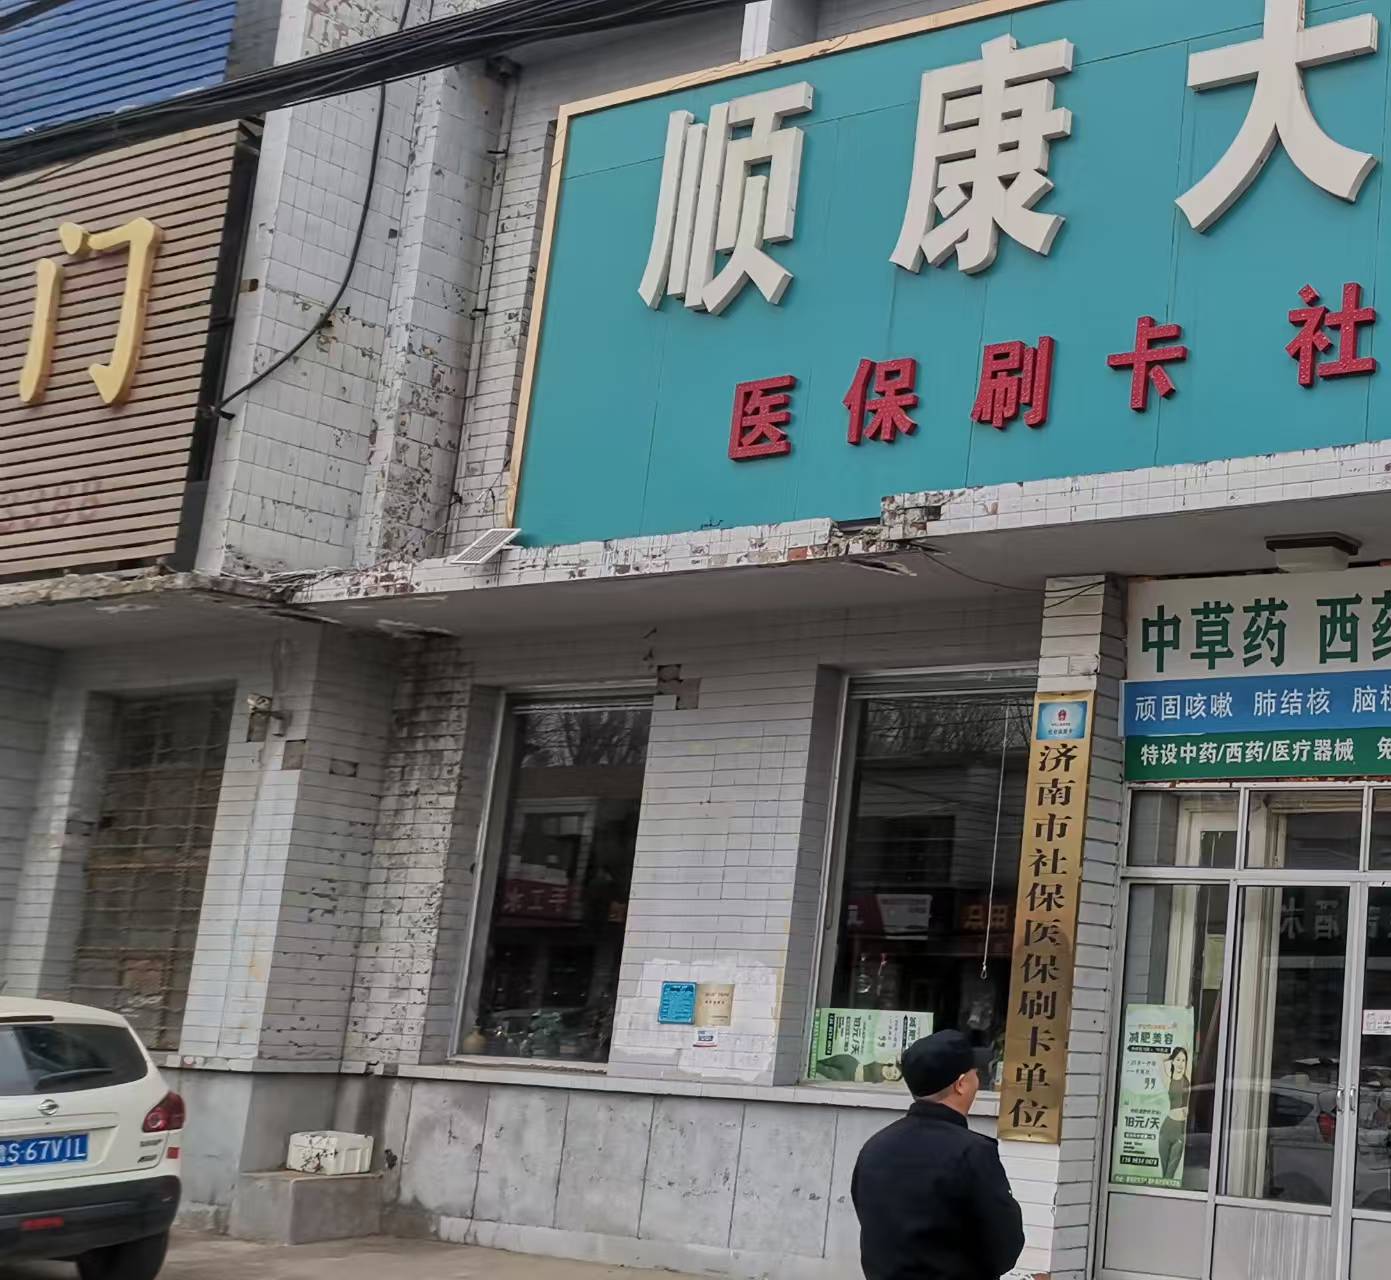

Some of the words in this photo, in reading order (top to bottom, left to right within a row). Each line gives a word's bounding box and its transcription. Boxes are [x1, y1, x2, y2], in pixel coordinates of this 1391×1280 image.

[18, 217, 163, 407] 门
[1141, 598, 1288, 673] 中草药
[1134, 692, 1233, 722] 顽固咳嗽
[1253, 685, 1332, 717] 肺结核
[1140, 737, 1355, 765] 特设中药/西药/医疗器械
[1008, 742, 1078, 1129] 济南市社保医保刷卡单位
